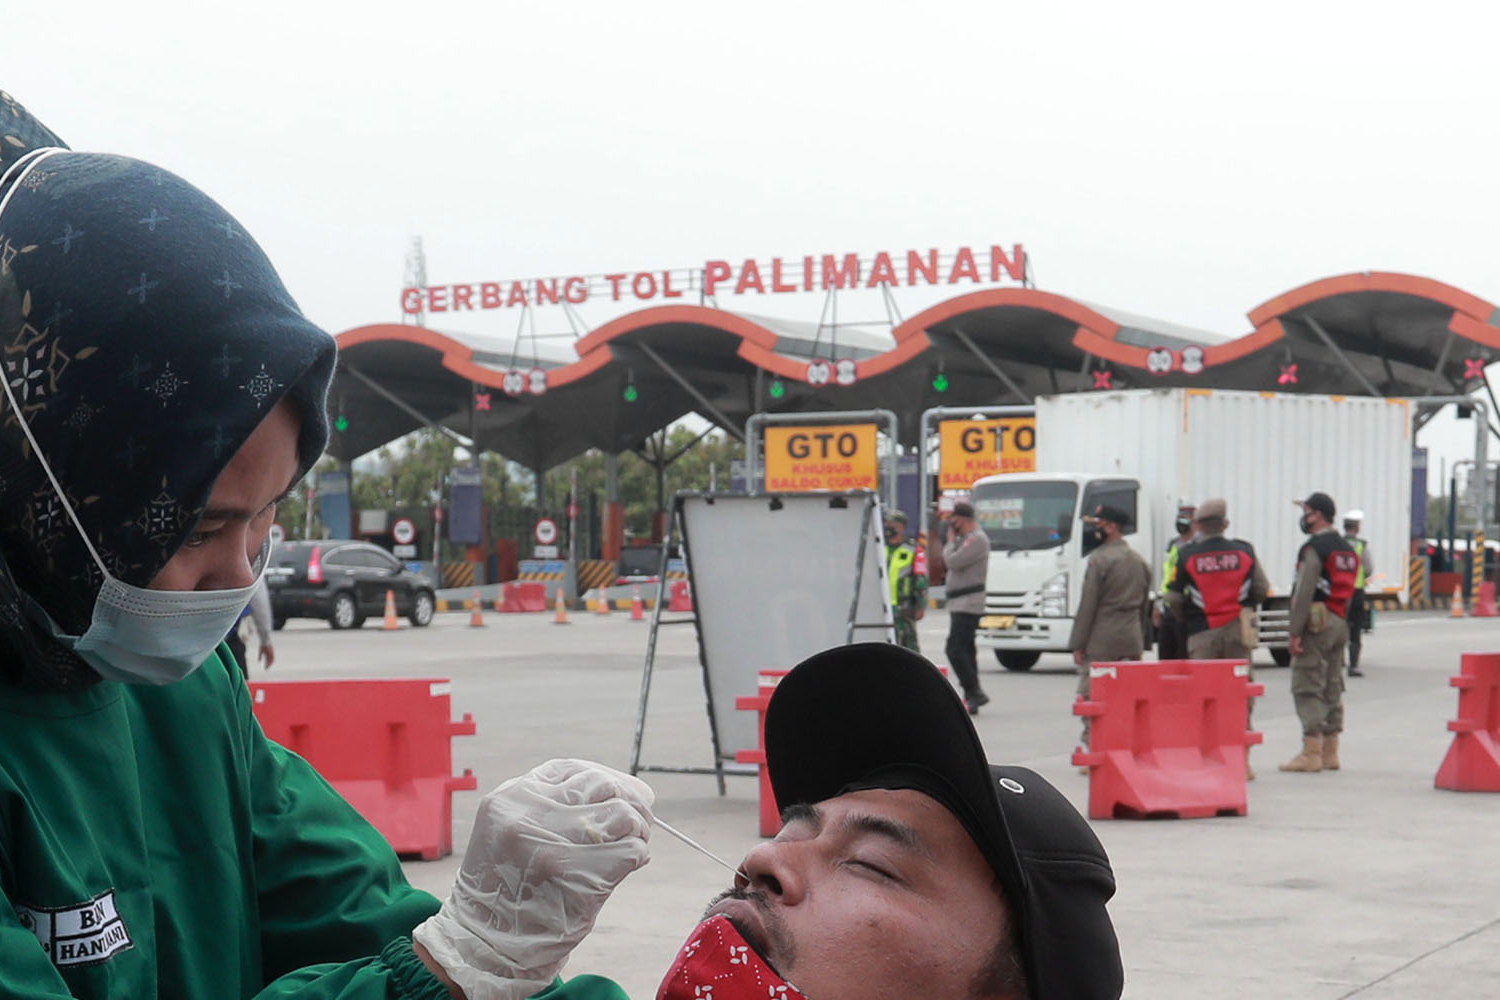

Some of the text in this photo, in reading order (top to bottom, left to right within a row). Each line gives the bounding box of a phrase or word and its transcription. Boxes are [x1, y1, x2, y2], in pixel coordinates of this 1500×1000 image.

[400, 243, 1024, 314] GERBANG TOL PALIMANAN
[786, 433, 858, 458] GTO
[962, 426, 1035, 453] GTO
